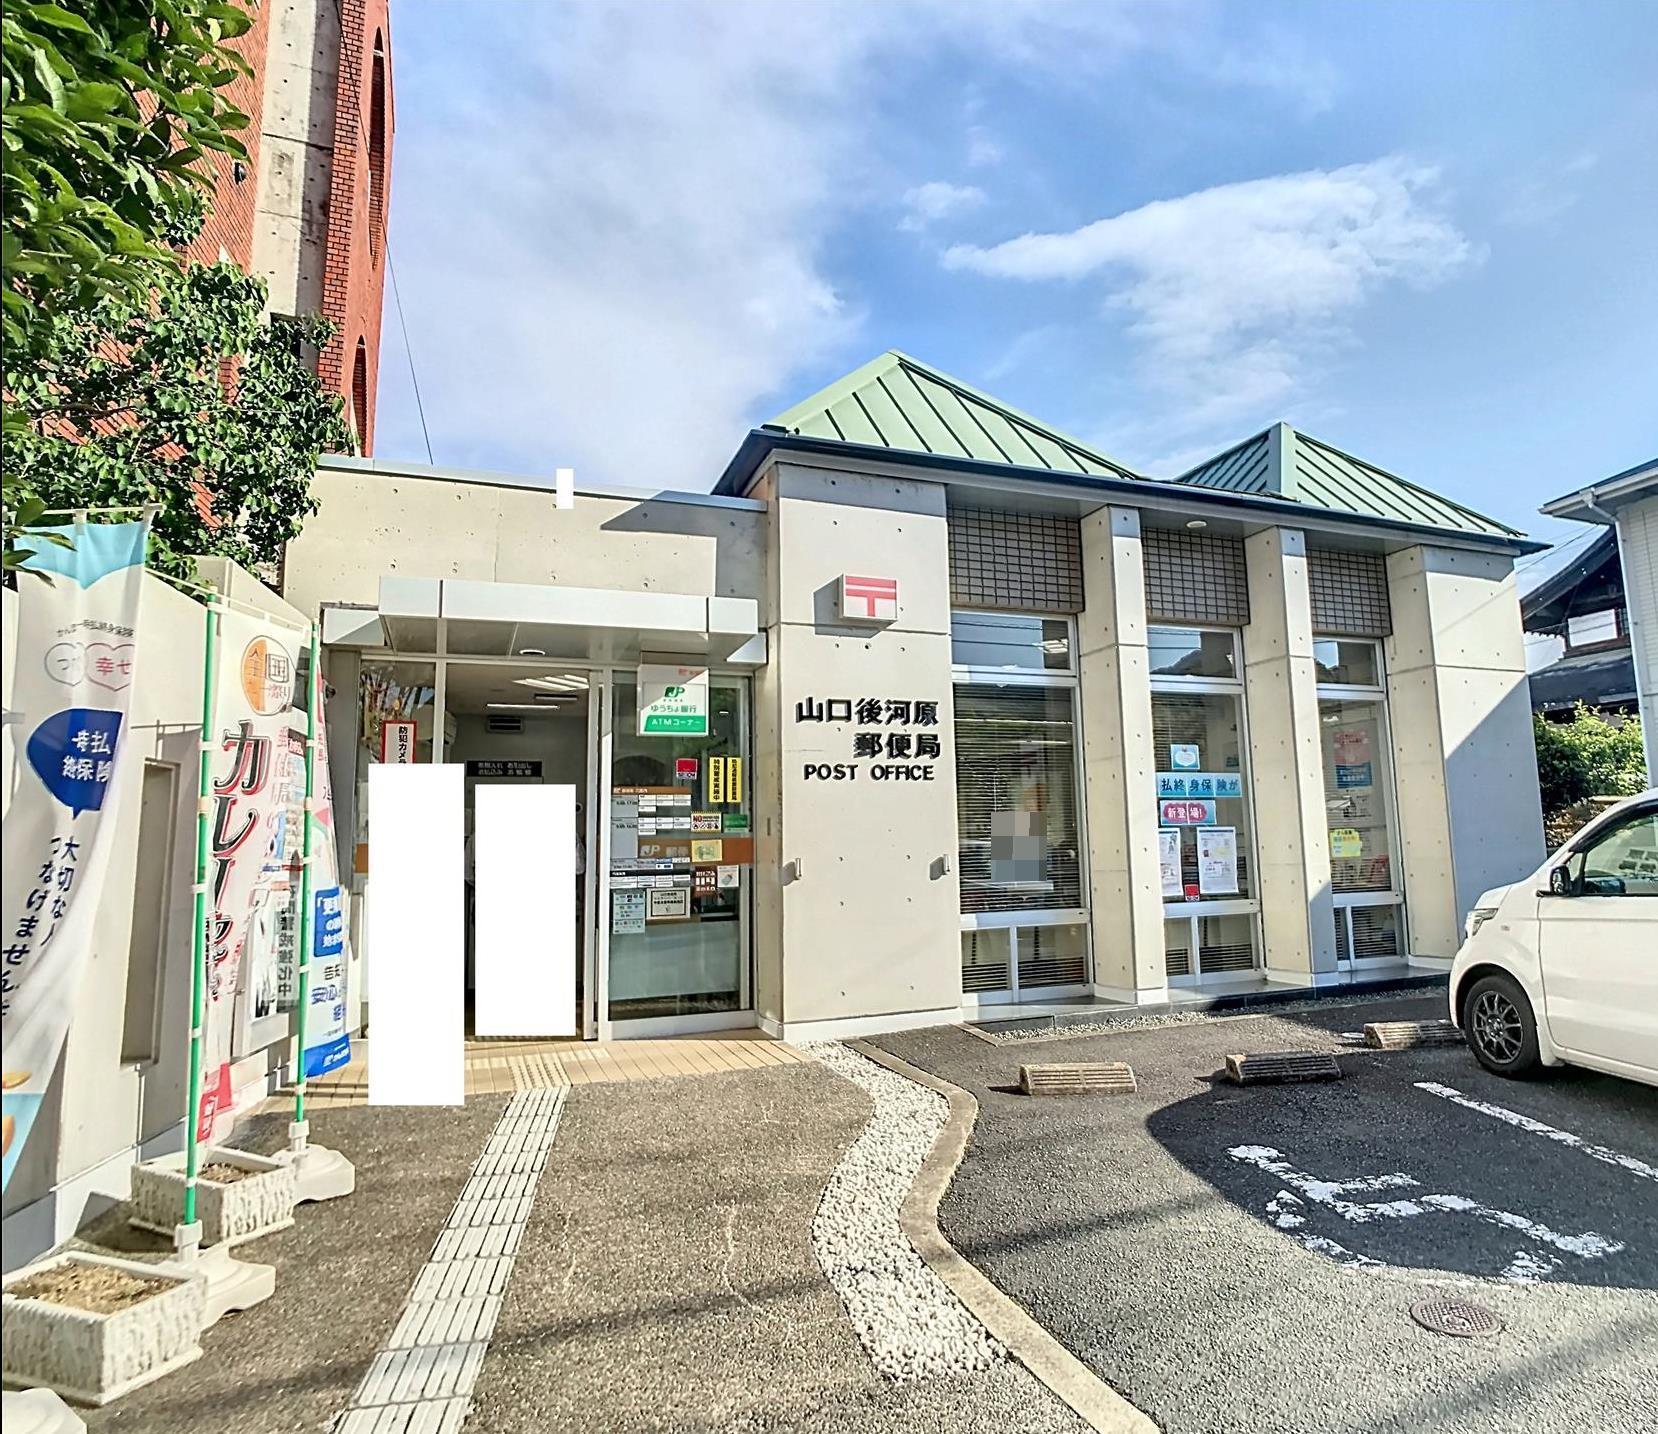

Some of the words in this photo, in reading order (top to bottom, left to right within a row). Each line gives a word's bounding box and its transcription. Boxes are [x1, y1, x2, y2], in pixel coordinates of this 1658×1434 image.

[795, 697, 939, 727] 山口後河原
[853, 732, 941, 759] 郵便局
[804, 764, 858, 781] POST
[870, 765, 935, 781] OFFICE
[1161, 777, 1239, 793] 払終身保険が
